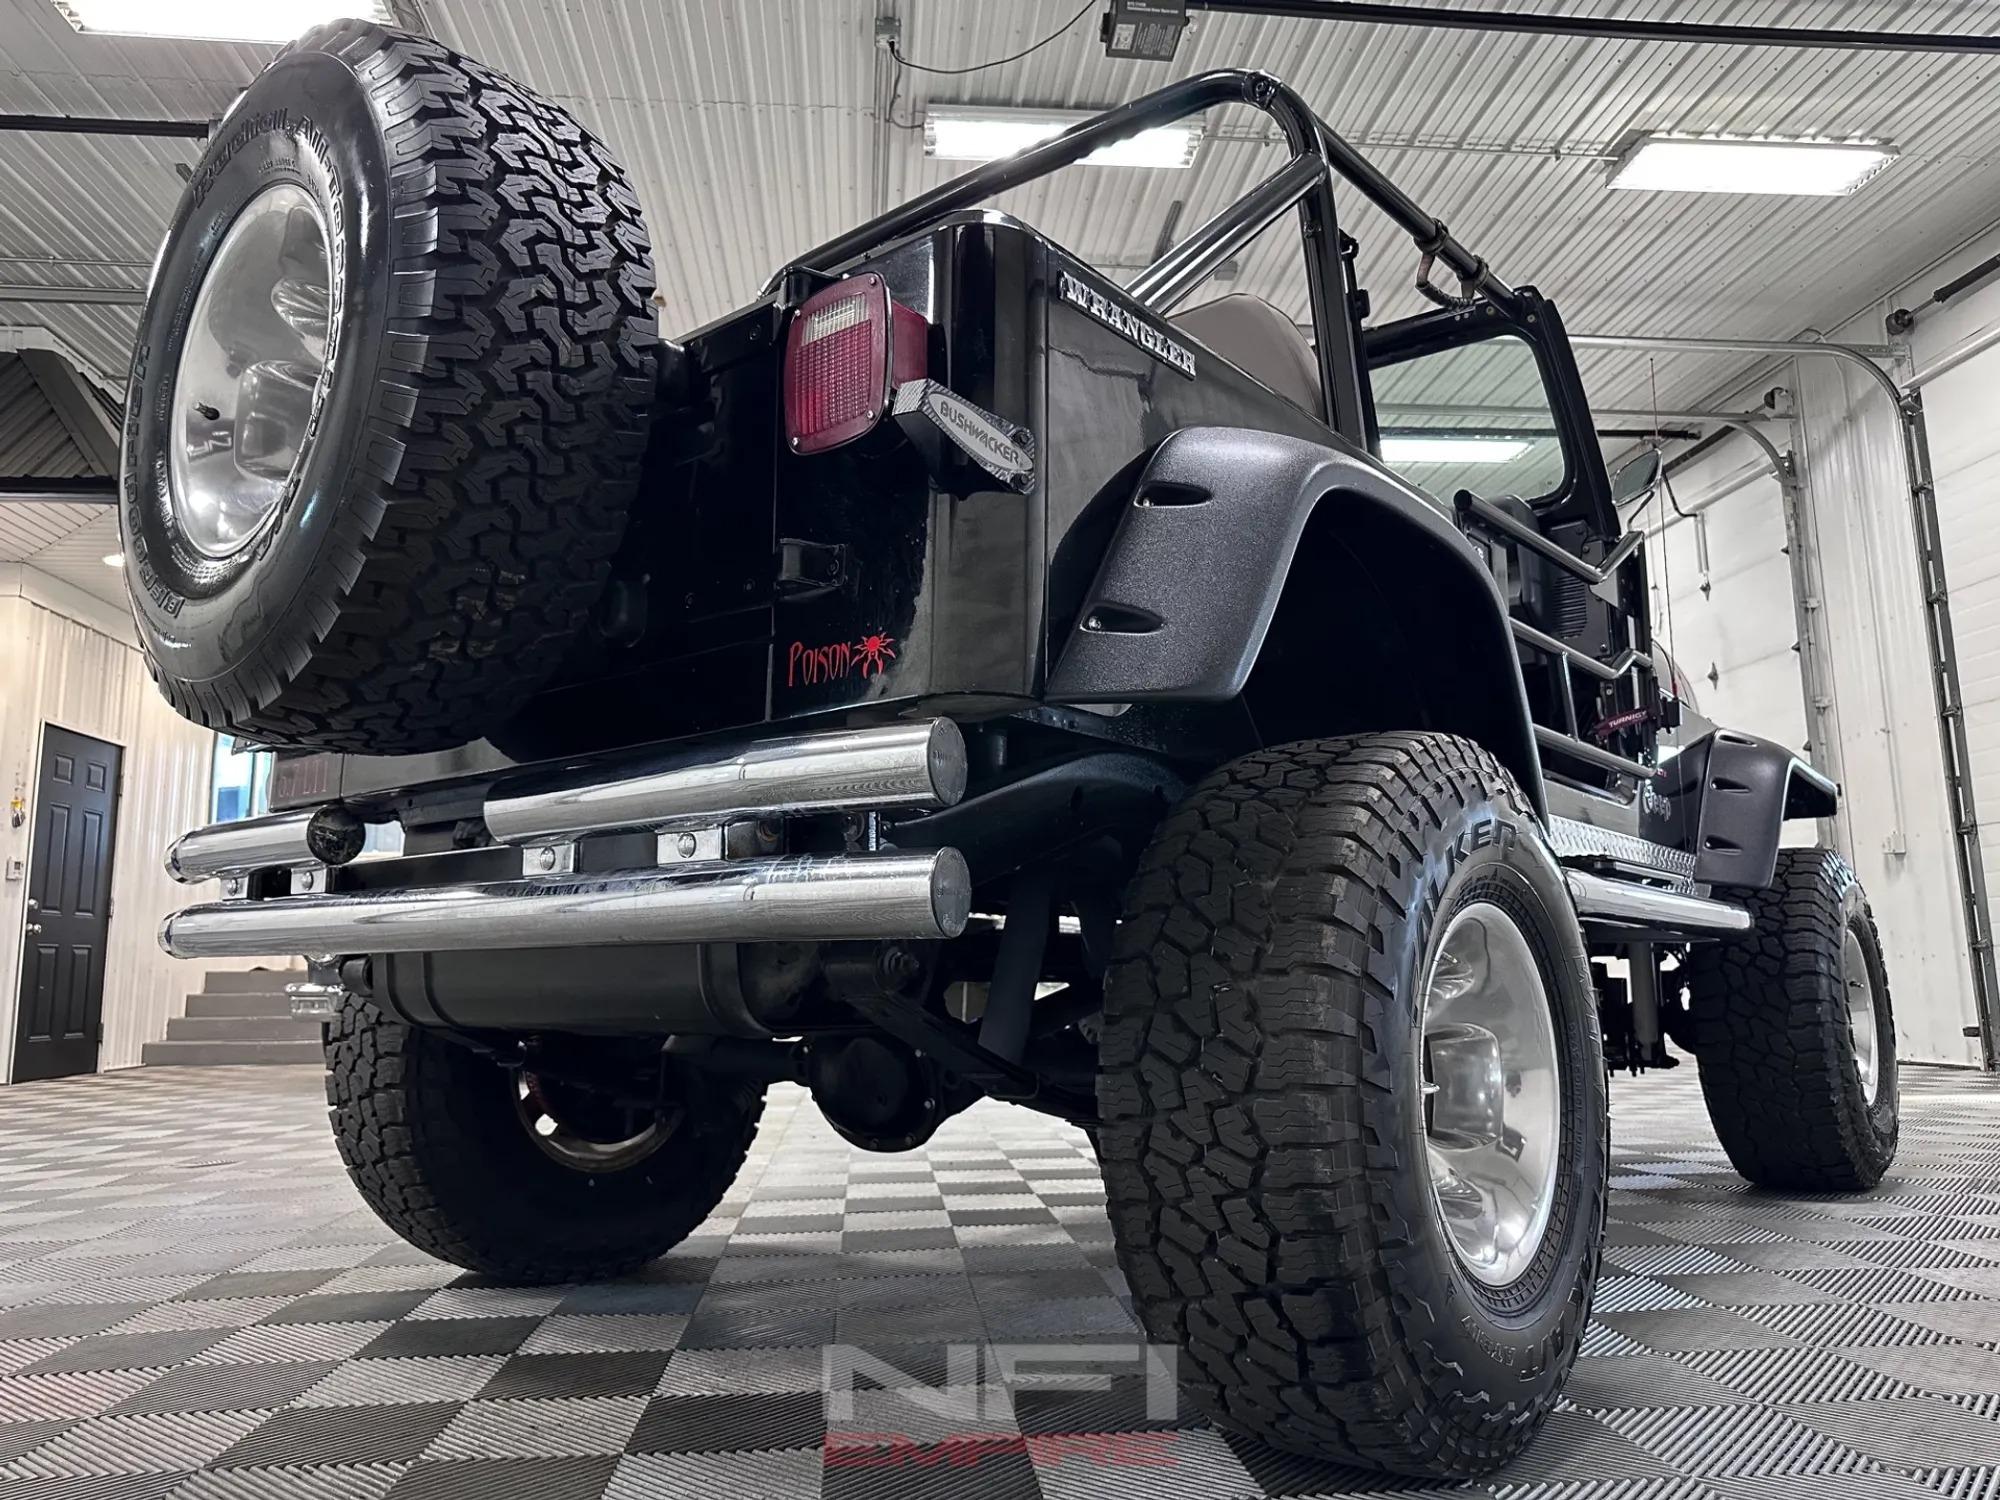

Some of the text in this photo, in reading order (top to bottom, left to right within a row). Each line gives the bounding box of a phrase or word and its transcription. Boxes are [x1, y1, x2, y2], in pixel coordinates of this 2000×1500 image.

[1060, 271, 1197, 376] WRANGLER
[938, 401, 1021, 465] BUSHWACKER
[1608, 710, 1648, 728] TURNIGY
[1643, 785, 1671, 821] Jeep
